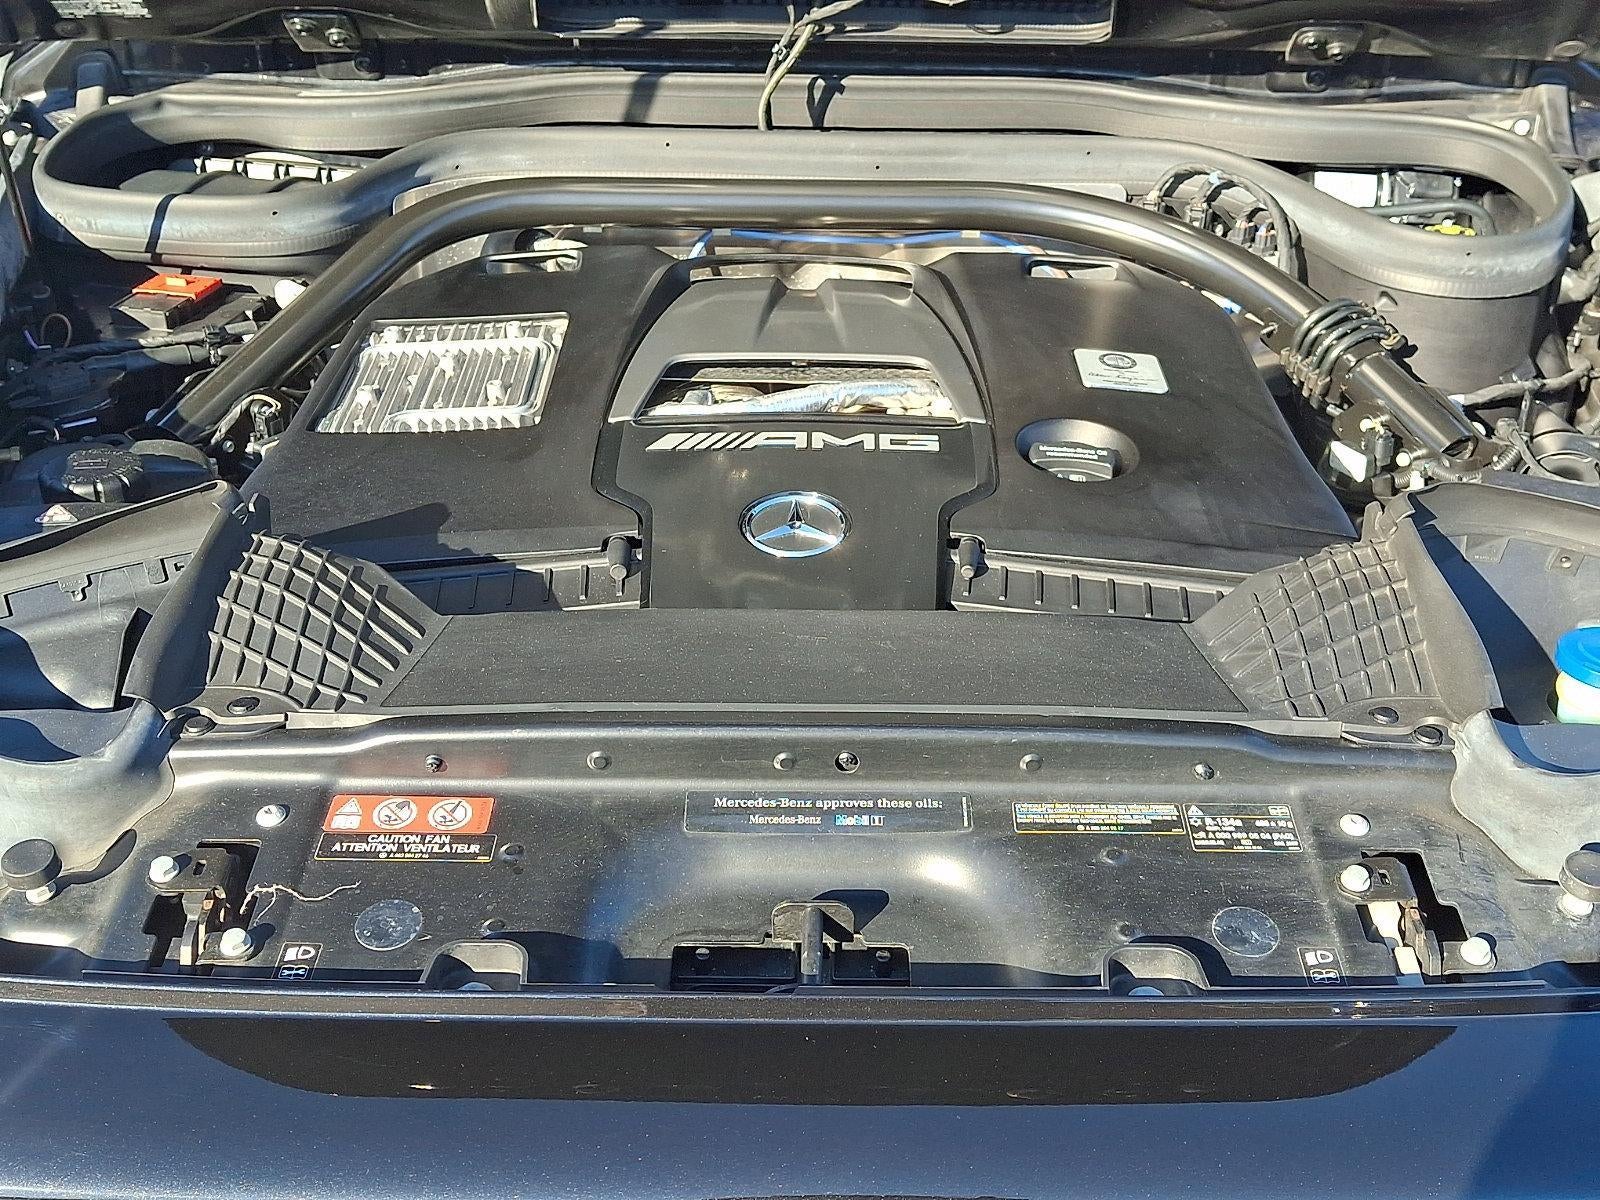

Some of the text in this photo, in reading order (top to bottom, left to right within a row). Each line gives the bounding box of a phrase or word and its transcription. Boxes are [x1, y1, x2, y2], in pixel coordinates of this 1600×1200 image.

[740, 431, 940, 452] AMG
[714, 797, 943, 810] Mercedes-Benz approves these oils:
[749, 814, 821, 825] Mercedes-Benz
[368, 834, 450, 844] CAUTION FAN
[331, 842, 480, 854] ATTENTION VENTILATEUR
